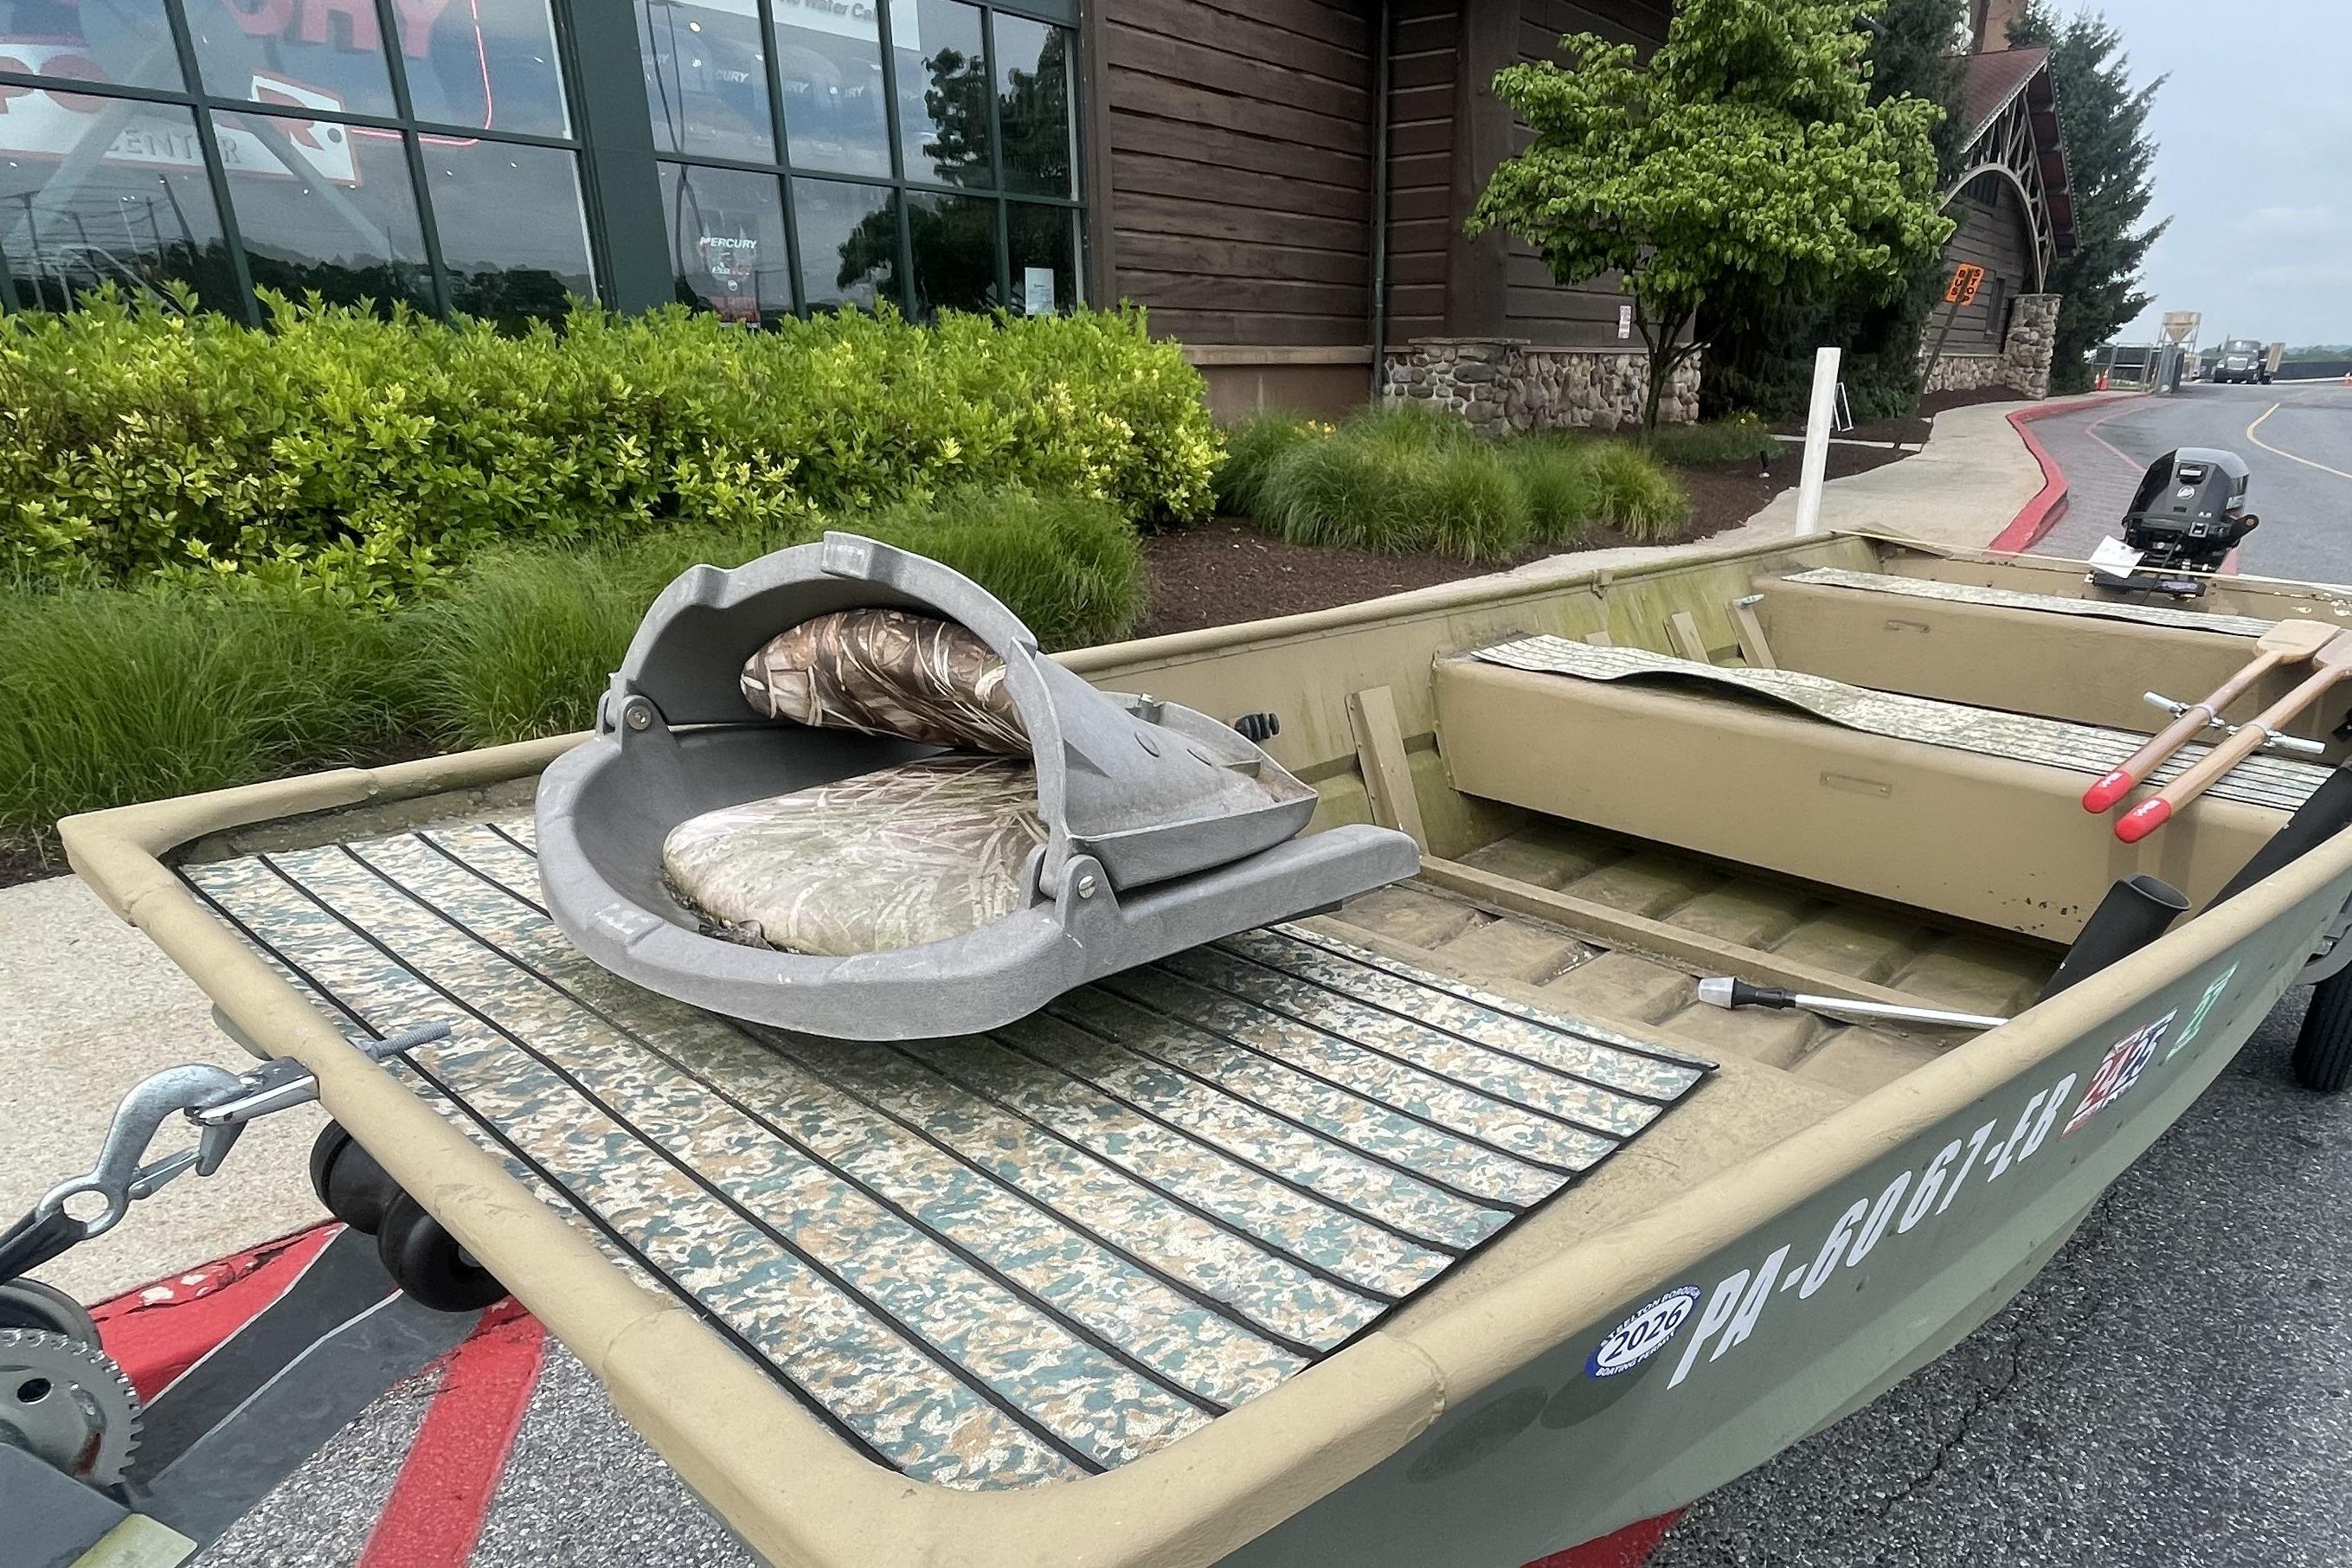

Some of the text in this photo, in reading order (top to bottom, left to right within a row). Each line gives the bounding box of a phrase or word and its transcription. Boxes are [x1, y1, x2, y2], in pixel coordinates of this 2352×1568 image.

[699, 236, 758, 249] MERCURY
[1951, 269, 1966, 296] BUS
[1961, 268, 1982, 303] STOP
[2071, 1023, 2169, 1119] 24 25
[1603, 1298, 1687, 1364] 2026
